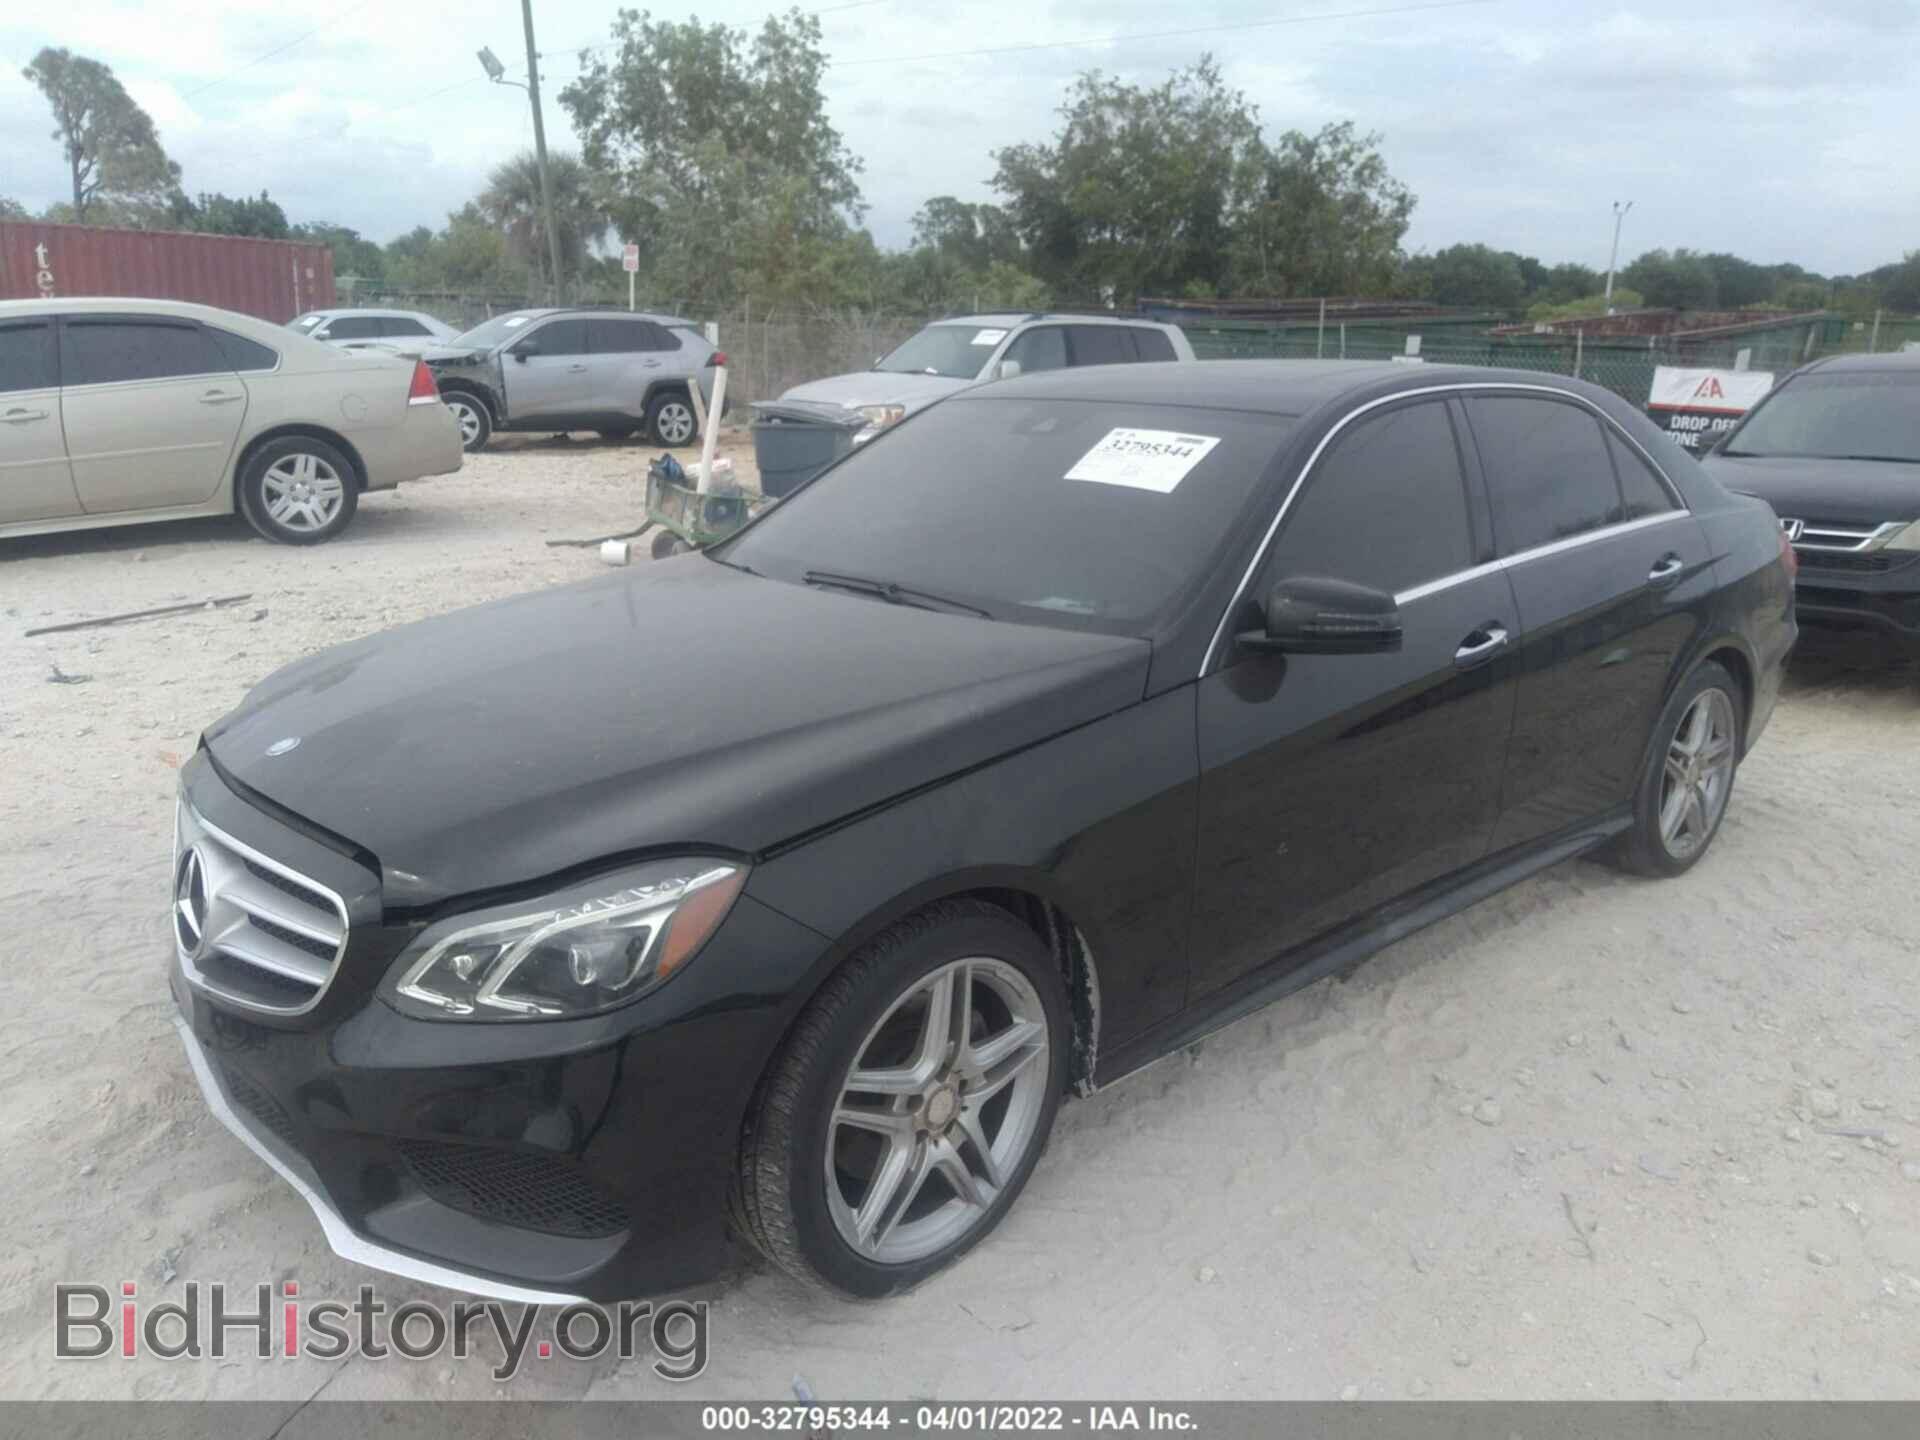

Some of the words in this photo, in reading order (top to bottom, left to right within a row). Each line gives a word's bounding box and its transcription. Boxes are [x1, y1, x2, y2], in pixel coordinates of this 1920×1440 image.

[1671, 415, 1709, 431] DROP
[1665, 430, 1700, 447] ONE
[1105, 439, 1194, 459] 32795344
